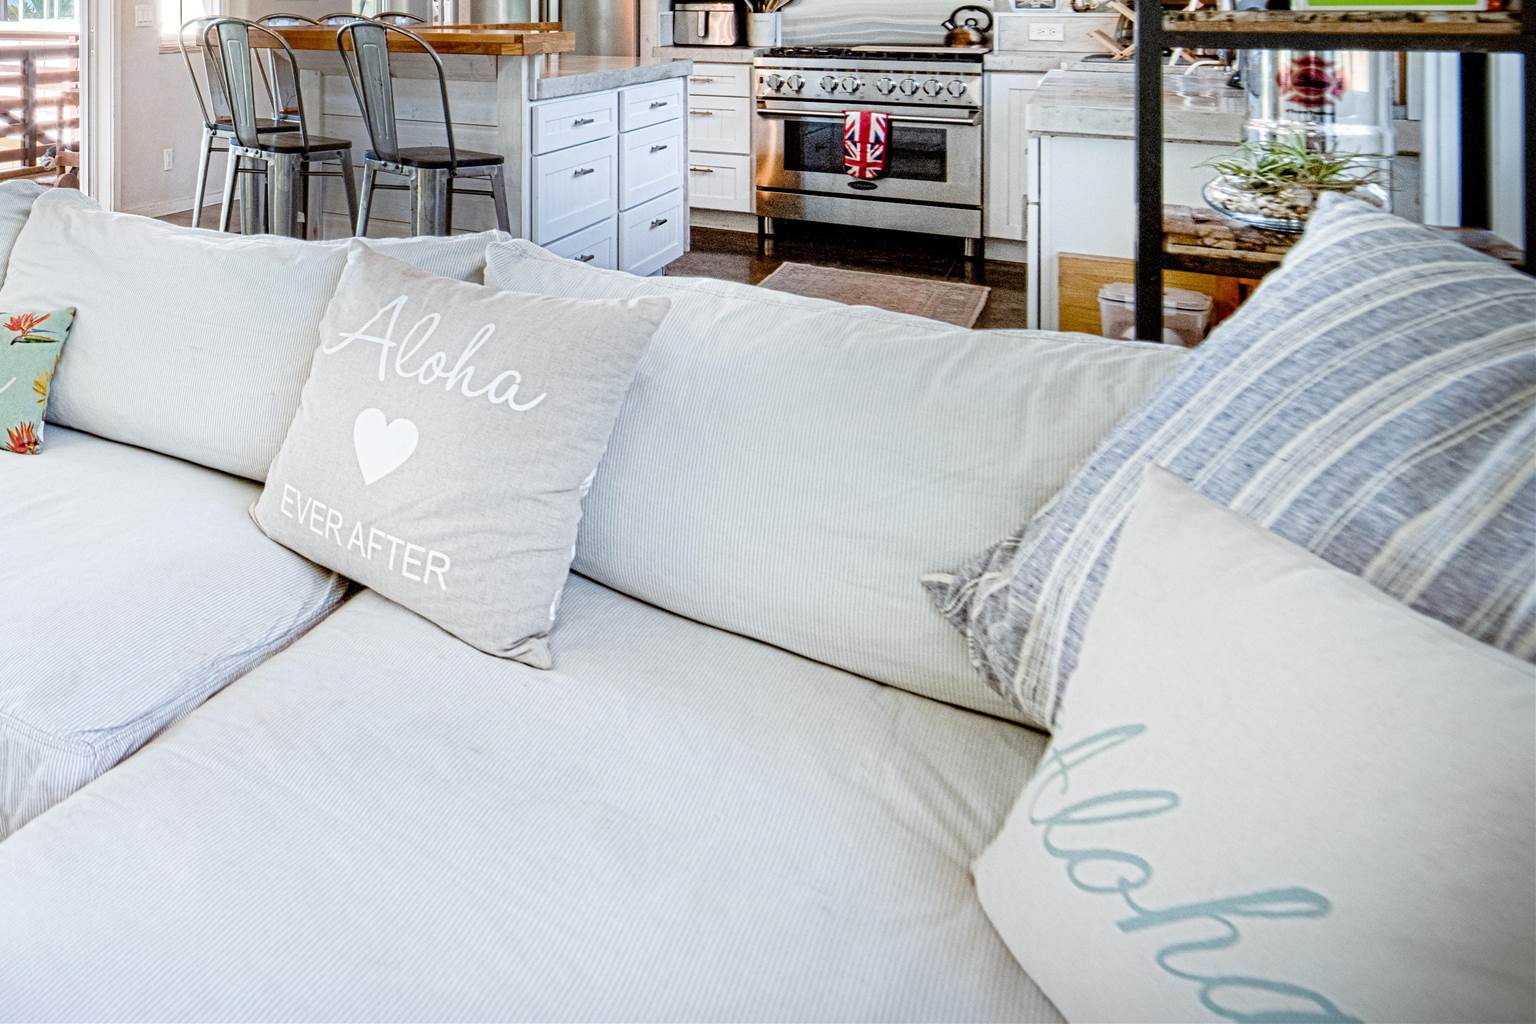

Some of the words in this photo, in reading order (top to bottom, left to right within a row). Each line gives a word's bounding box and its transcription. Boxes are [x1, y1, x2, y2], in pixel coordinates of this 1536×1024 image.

[321, 295, 548, 413] Aloha
[279, 483, 344, 545] EVER
[346, 520, 452, 591] AFTER
